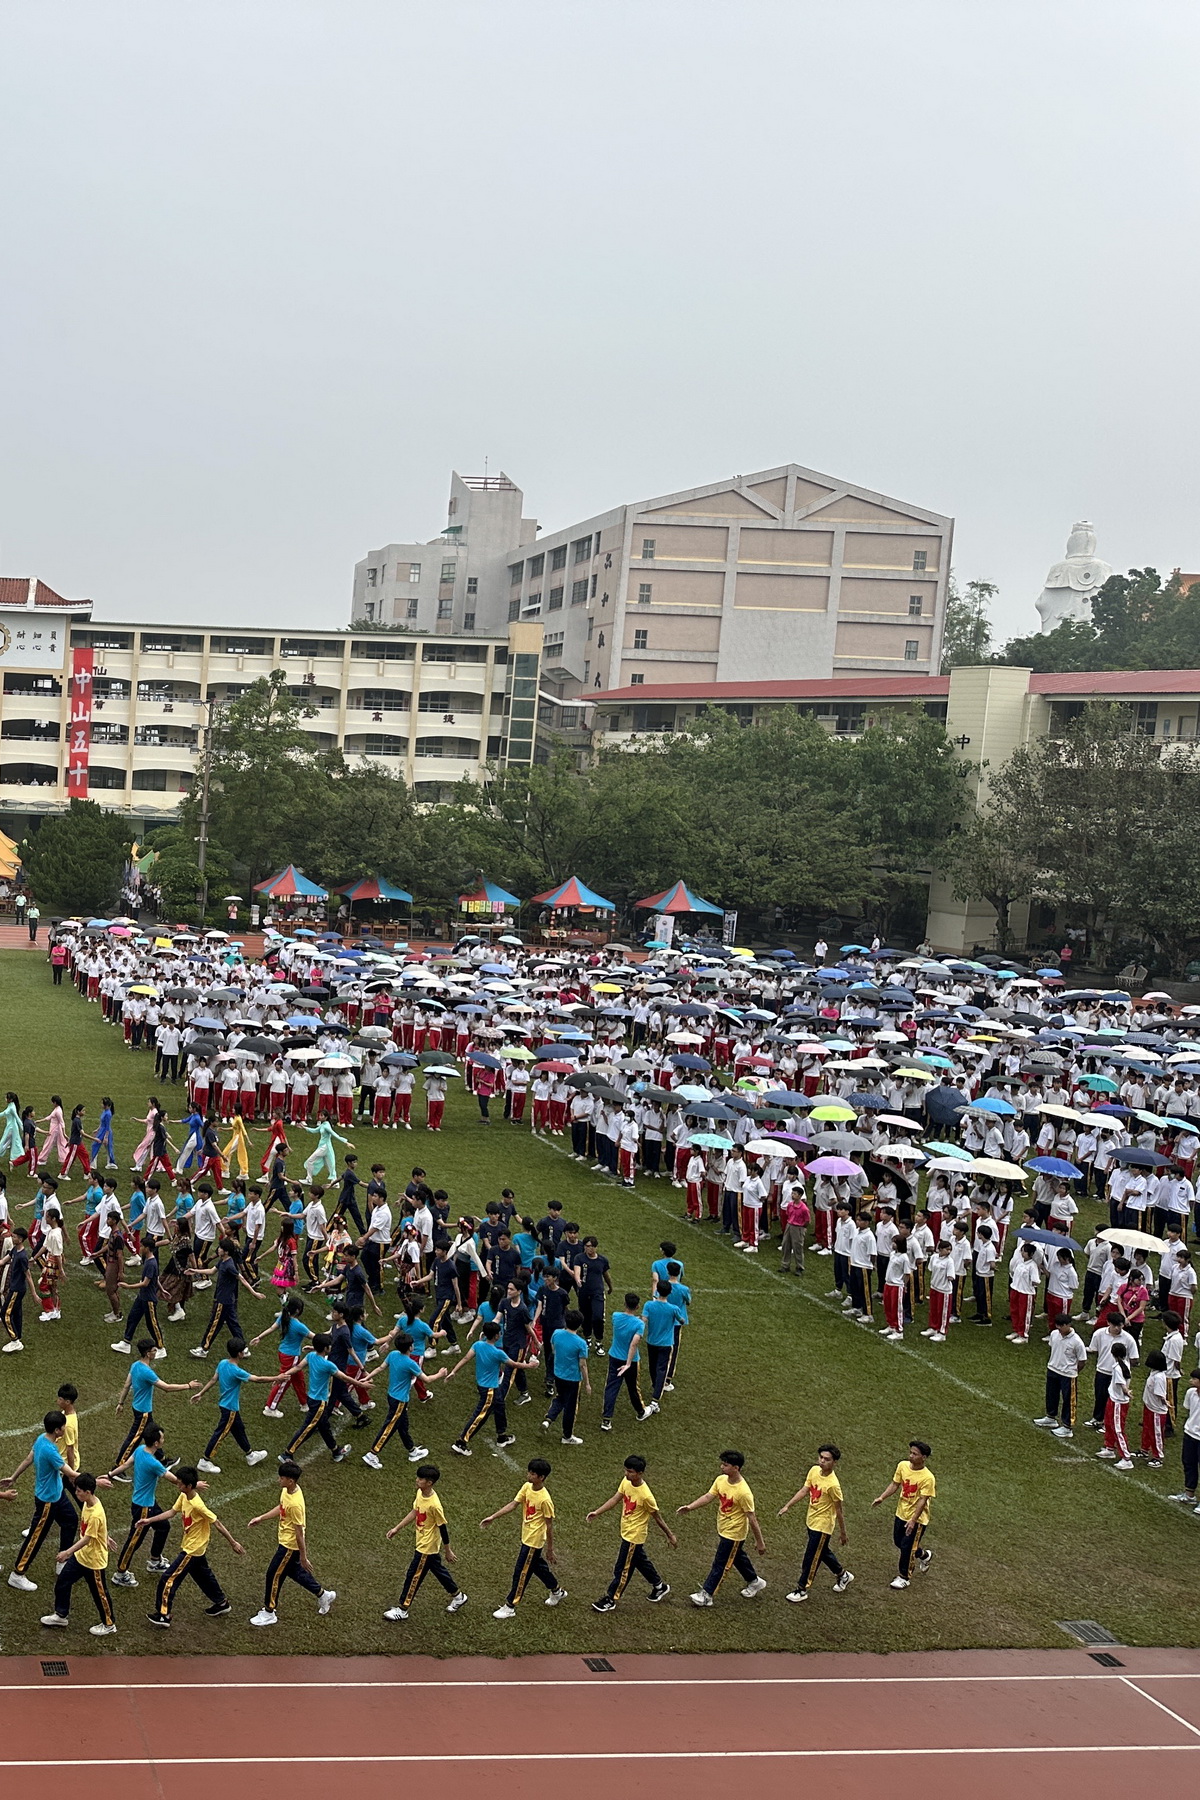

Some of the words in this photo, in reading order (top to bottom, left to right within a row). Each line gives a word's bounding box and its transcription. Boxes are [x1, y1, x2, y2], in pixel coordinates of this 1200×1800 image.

[16, 630, 26, 651] 耐心
[32, 631, 42, 651] 細心
[69, 667, 91, 786] 中山五十
